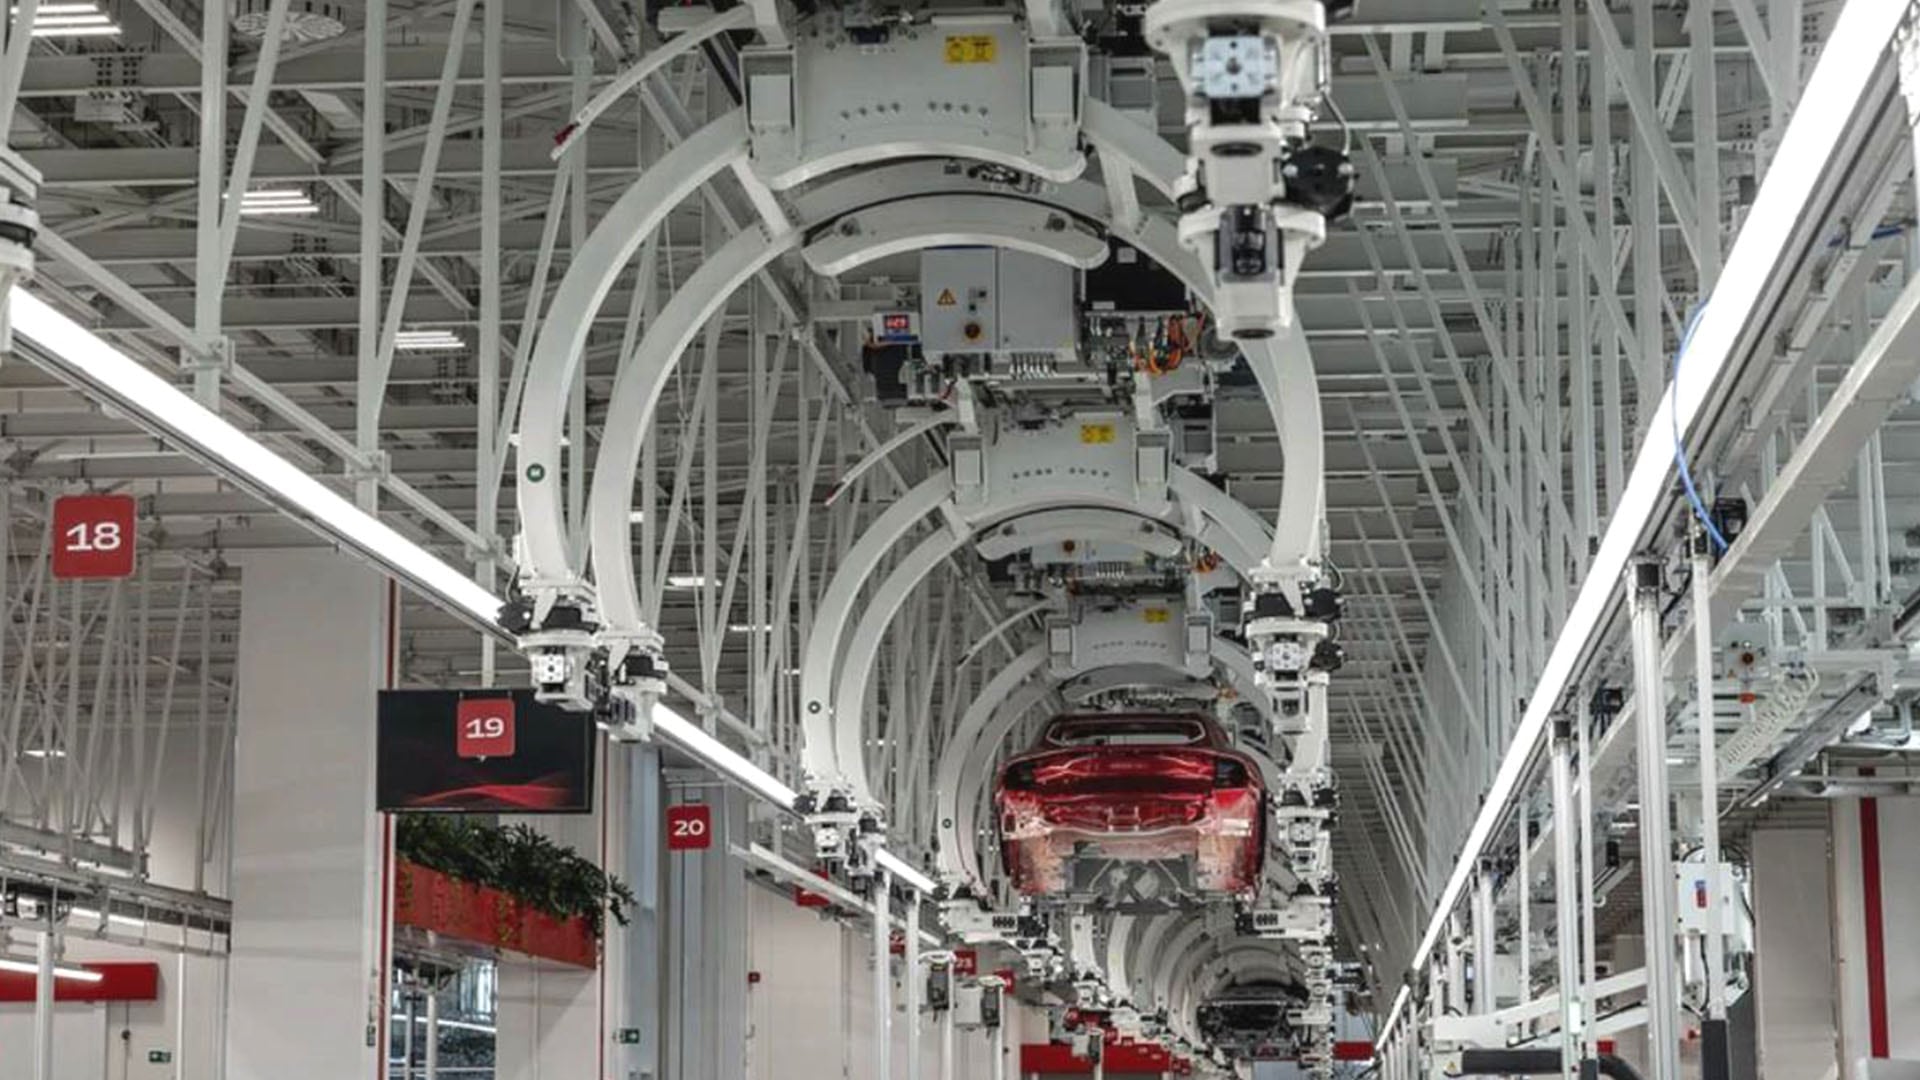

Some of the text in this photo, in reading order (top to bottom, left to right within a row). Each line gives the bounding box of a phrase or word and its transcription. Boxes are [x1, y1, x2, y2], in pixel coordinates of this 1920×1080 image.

[66, 522, 121, 551] 18
[466, 716, 505, 739] 19
[673, 819, 705, 836] 20
